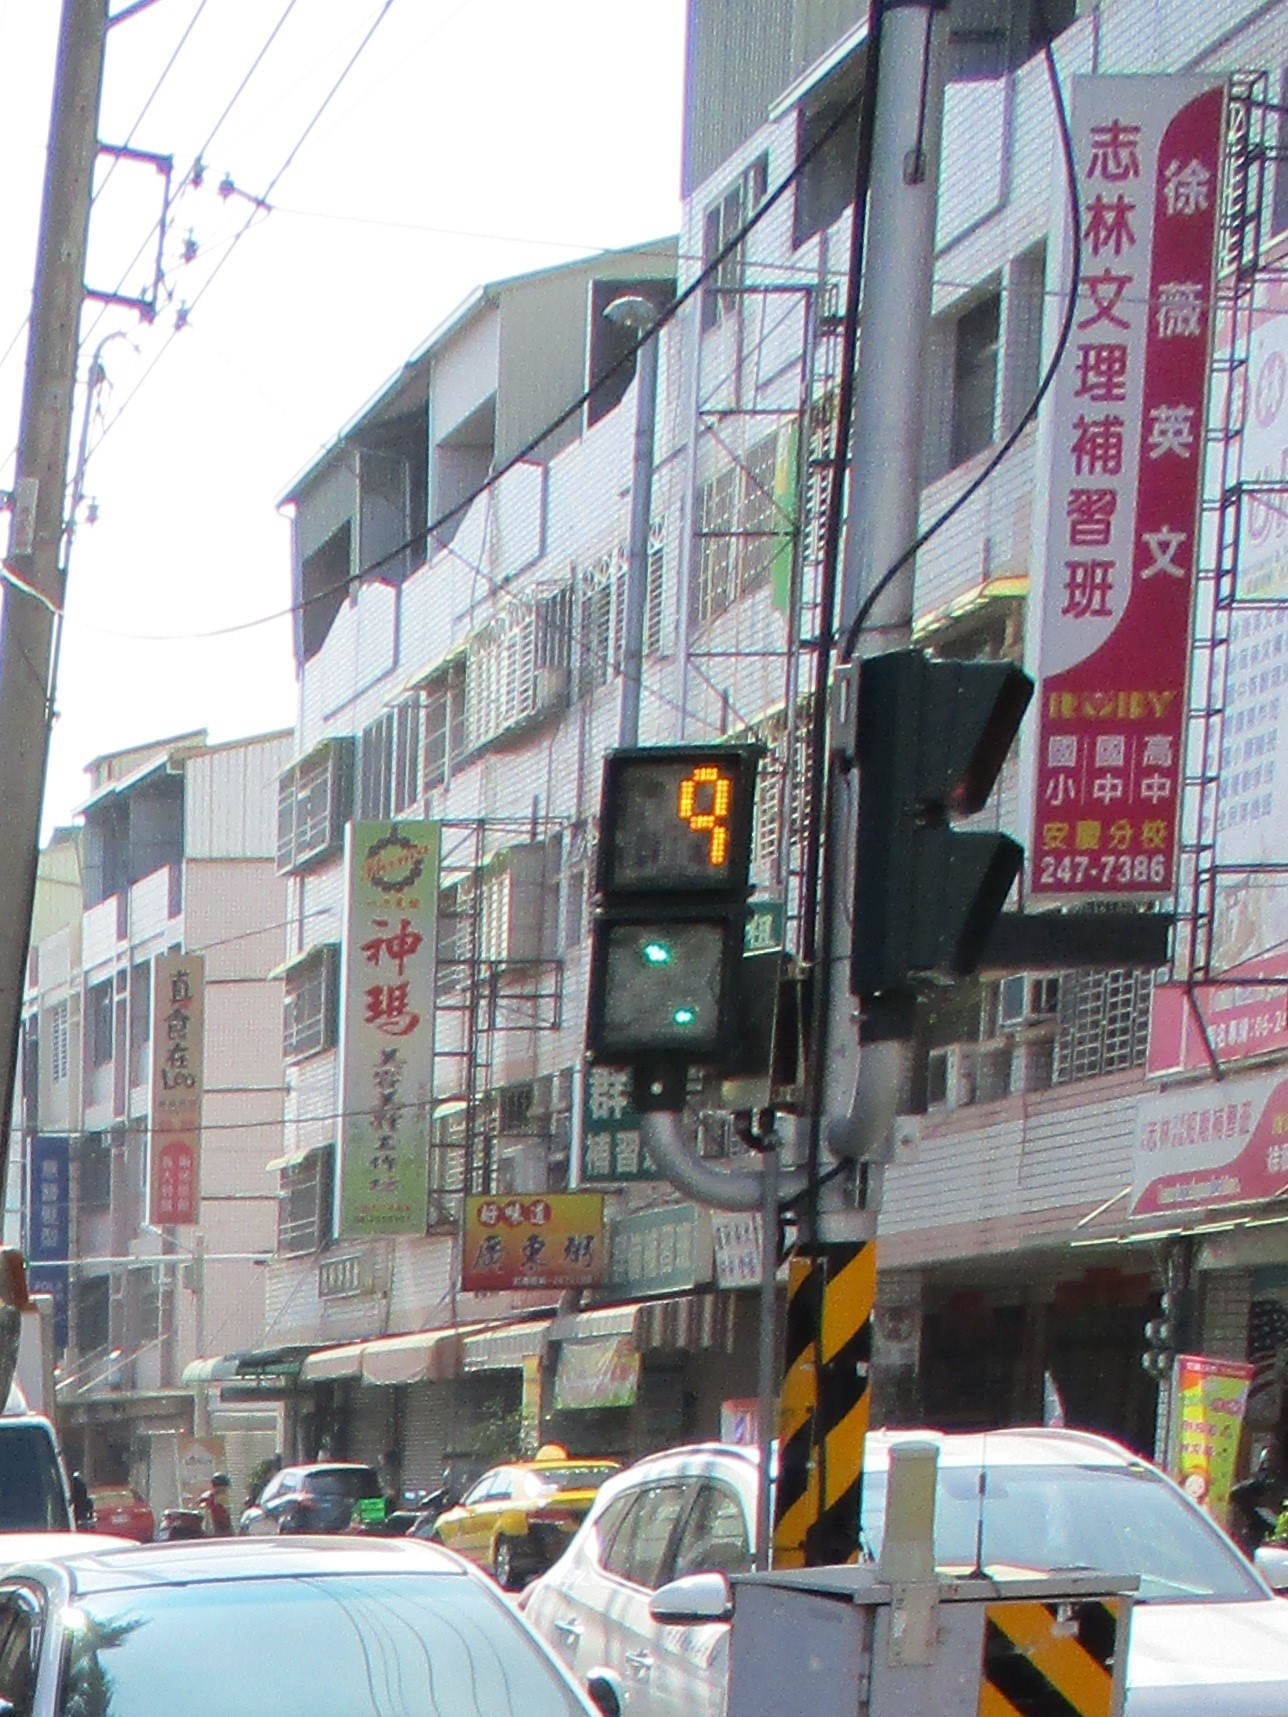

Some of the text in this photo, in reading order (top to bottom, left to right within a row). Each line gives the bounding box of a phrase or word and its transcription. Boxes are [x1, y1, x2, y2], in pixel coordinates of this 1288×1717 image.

[1061, 118, 1143, 620] 志林文理補習班
[1140, 158, 1210, 581] 徐薇英文
[676, 766, 730, 867] 9
[1042, 818, 1168, 850] 安慶分校
[1039, 853, 1166, 885] 247-7386
[478, 1201, 550, 1227] 好味道
